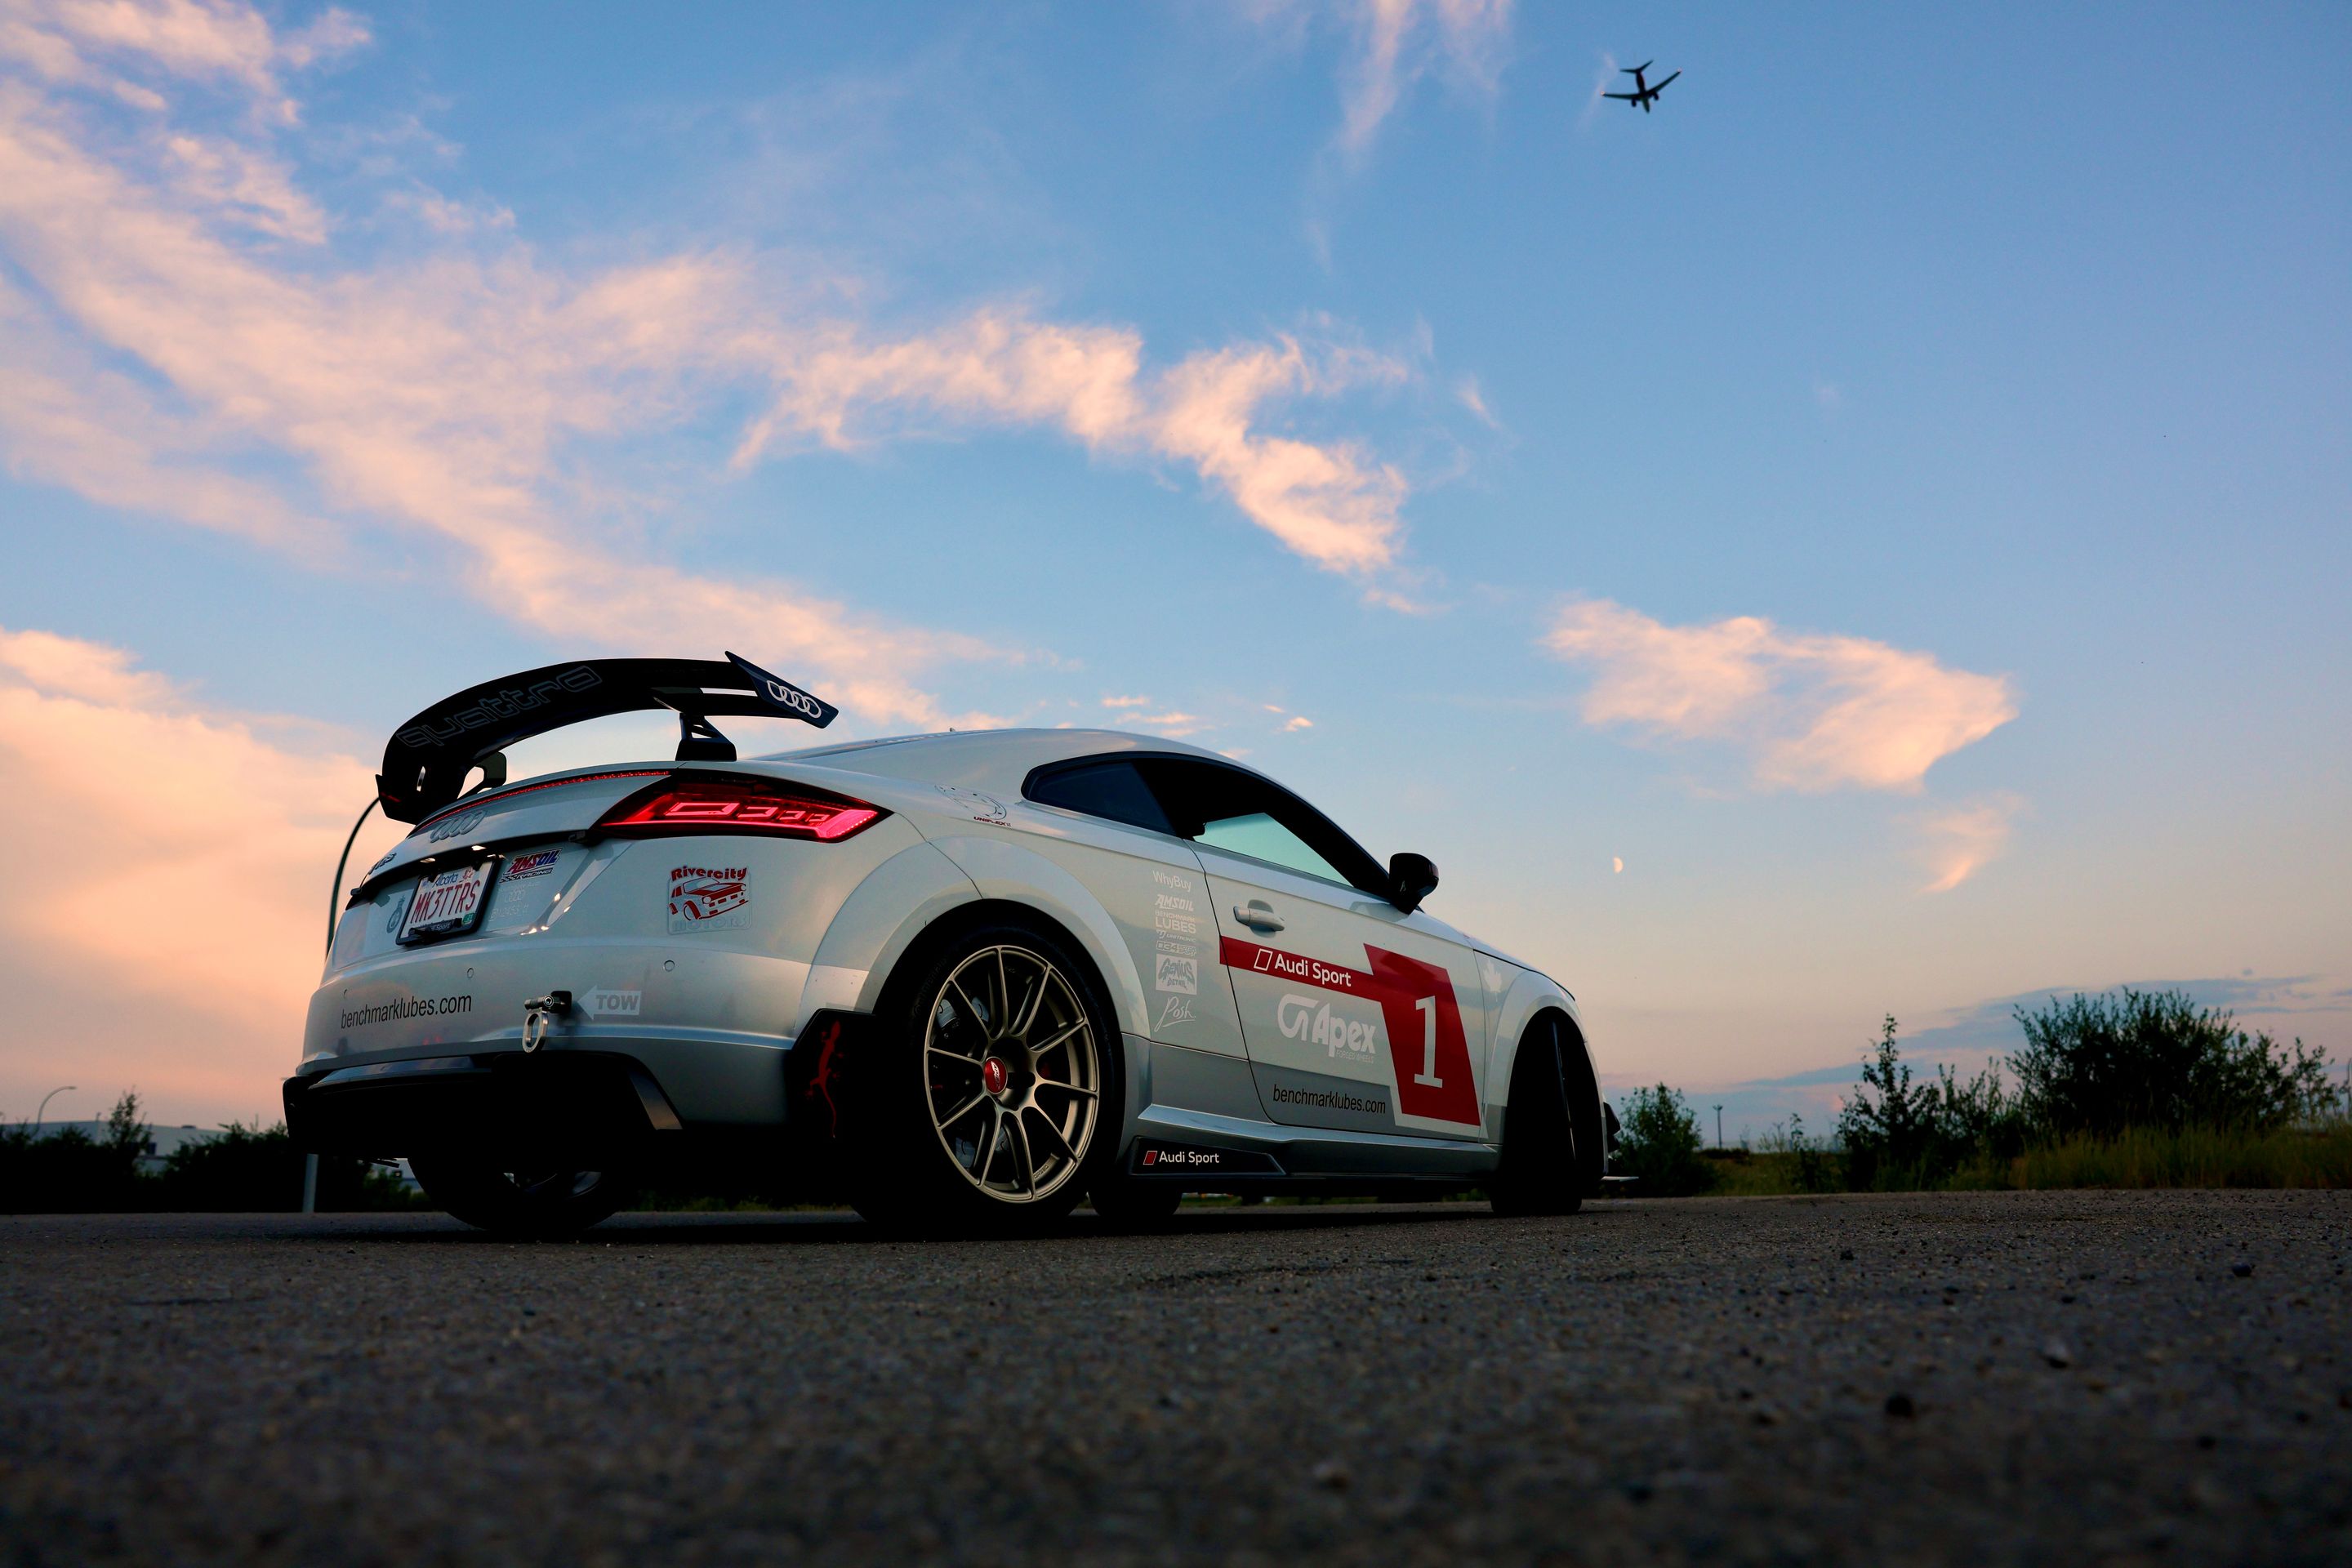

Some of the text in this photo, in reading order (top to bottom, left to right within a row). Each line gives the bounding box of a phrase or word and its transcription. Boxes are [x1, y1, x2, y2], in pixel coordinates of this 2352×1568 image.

[395, 665, 603, 747] quattro
[506, 849, 561, 874] AMSOIL
[671, 866, 747, 881] Rivercity
[1152, 871, 1192, 893] WhyBuy
[410, 880, 480, 924] MK3TTRS
[1155, 894, 1194, 912] AMSOIL
[1156, 916, 1196, 934] LUBES
[1275, 953, 1352, 987] Audi Sport
[341, 994, 472, 1029] benchmarklubes.com
[595, 994, 639, 1011] TOW
[1414, 996, 1443, 1088] 1
[1273, 1084, 1386, 1114] benchmarklubes.com
[1159, 1151, 1219, 1165] Audi Sport
